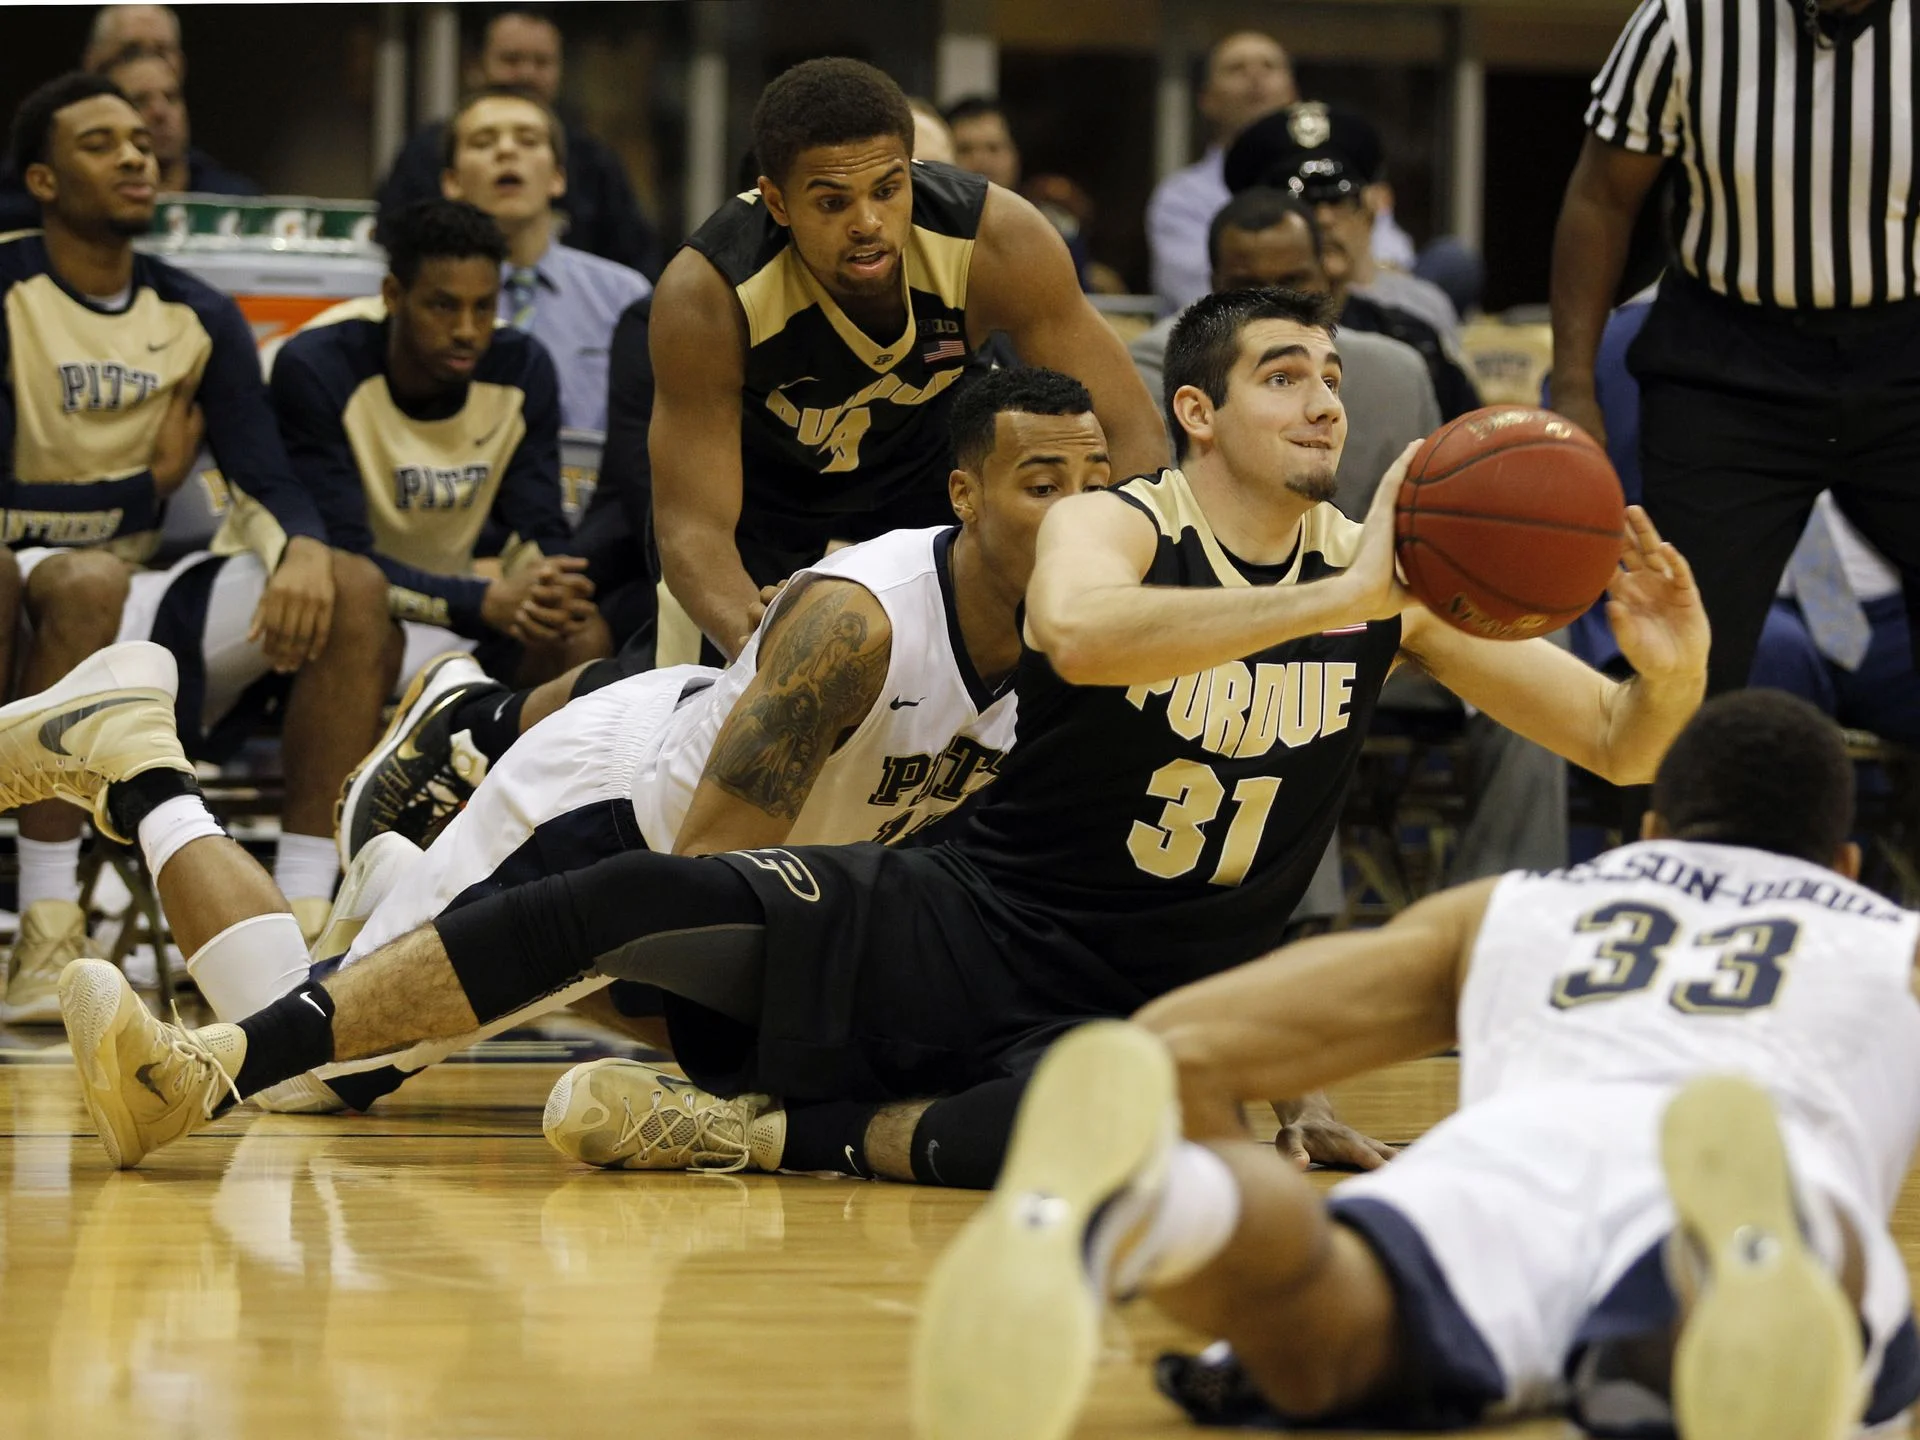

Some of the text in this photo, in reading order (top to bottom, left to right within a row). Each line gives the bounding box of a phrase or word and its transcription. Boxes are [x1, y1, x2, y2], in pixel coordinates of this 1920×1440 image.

[60, 362, 159, 413] PITT
[394, 463, 490, 509] PITT
[1126, 758, 1283, 887] 31
[1548, 899, 1803, 1015] 33
